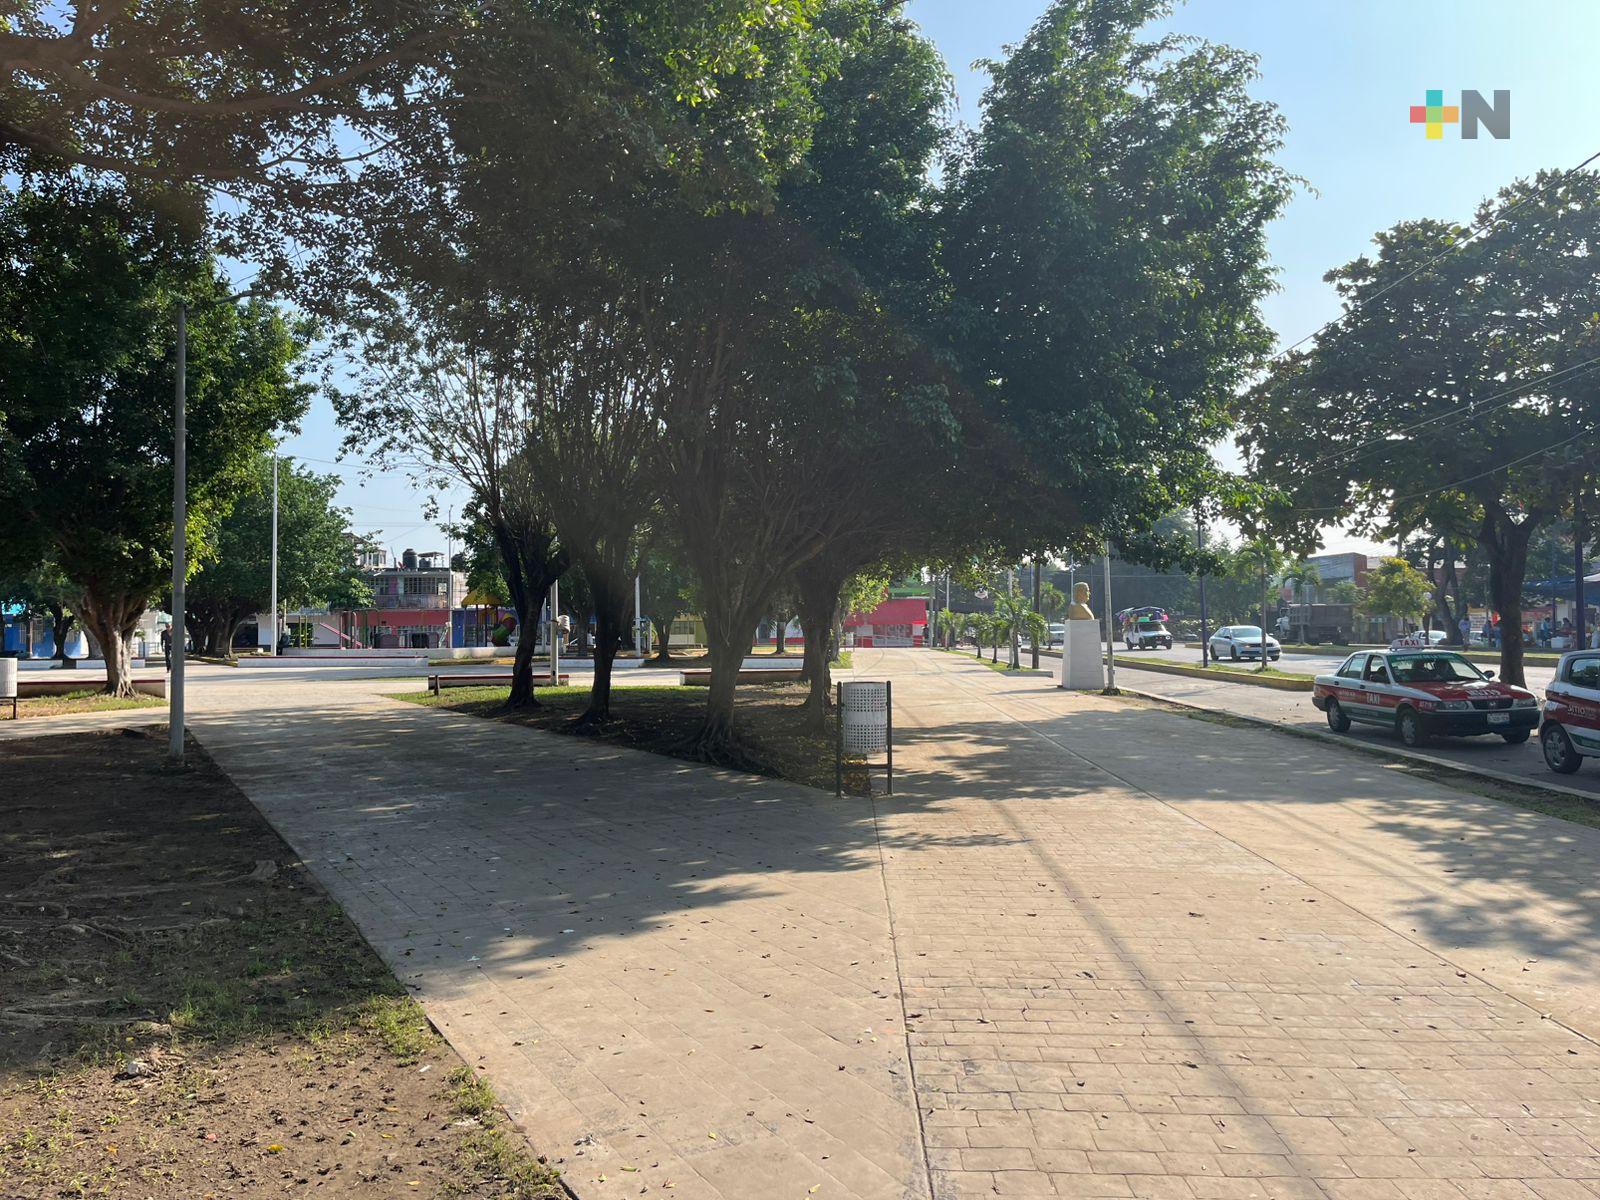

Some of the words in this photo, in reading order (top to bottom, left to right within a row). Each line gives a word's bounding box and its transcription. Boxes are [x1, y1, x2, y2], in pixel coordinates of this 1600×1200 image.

[1399, 639, 1420, 647] TAXI
[1366, 692, 1380, 705] TAXI
[1567, 704, 1586, 715] SITIO
